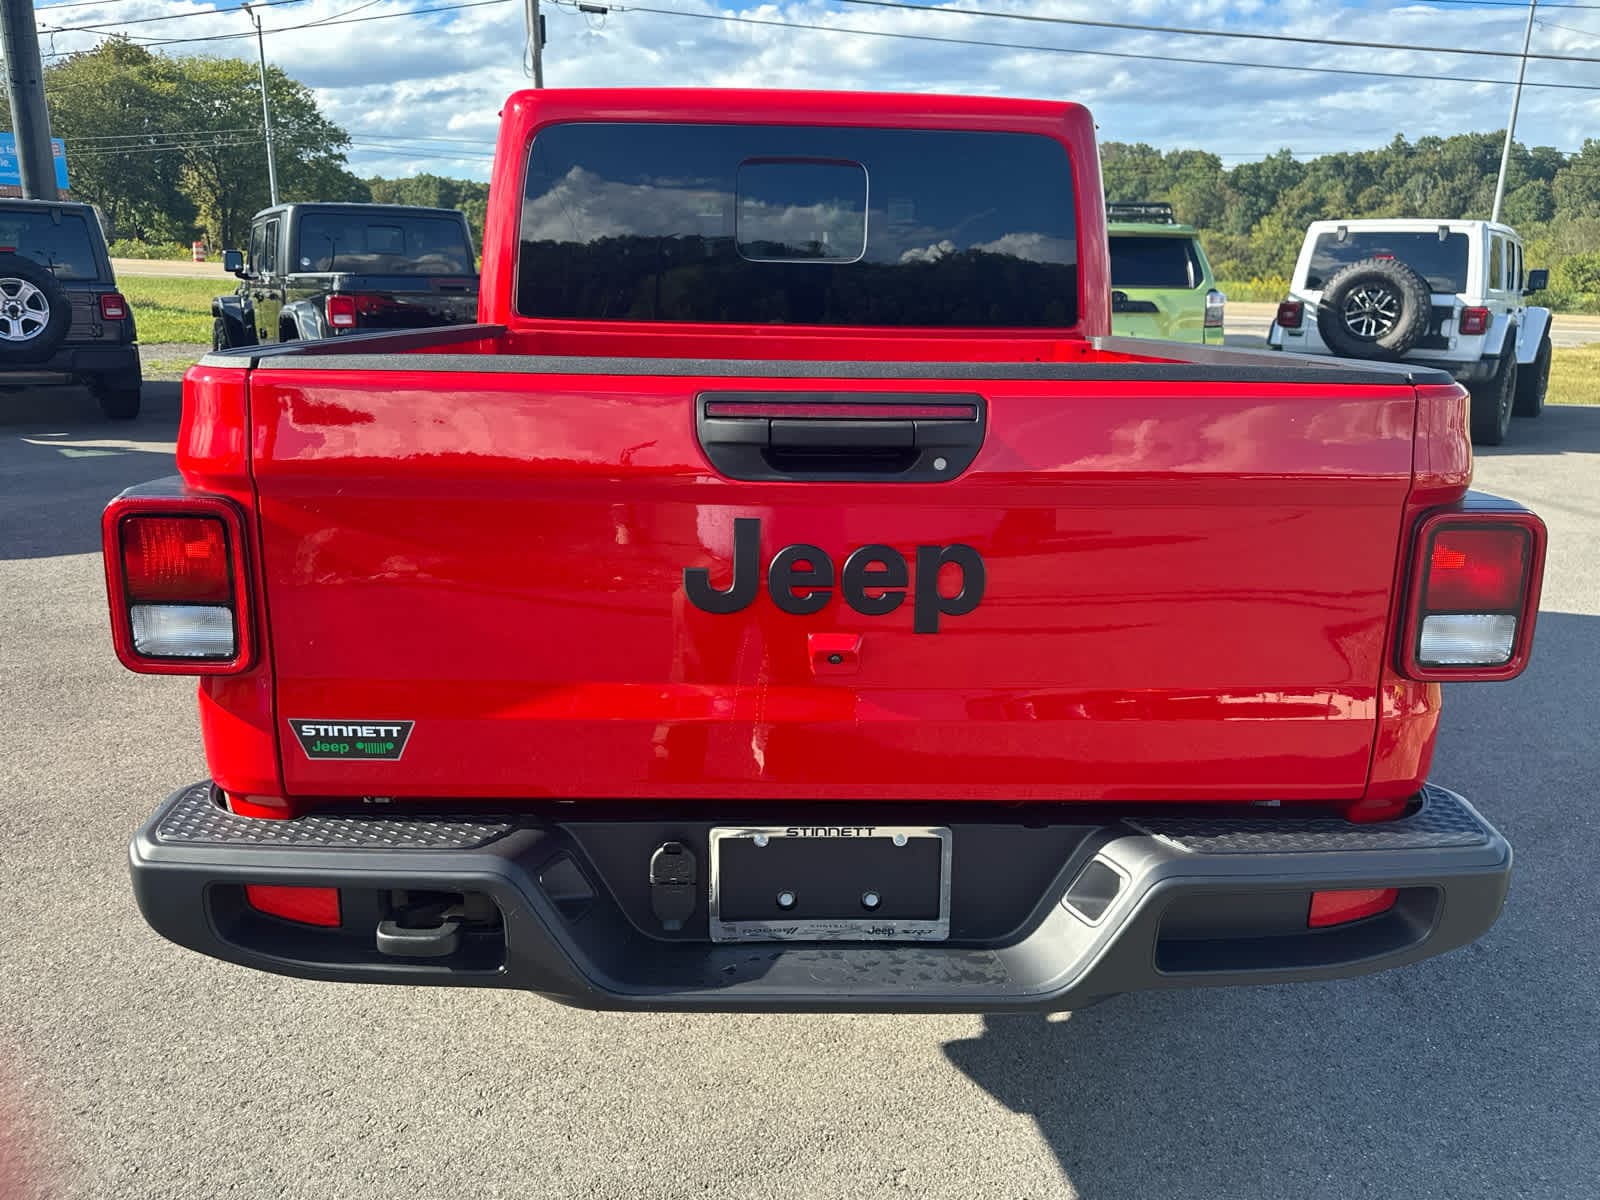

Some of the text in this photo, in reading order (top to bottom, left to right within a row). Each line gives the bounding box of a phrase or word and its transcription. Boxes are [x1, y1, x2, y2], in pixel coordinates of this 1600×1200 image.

[682, 518, 986, 634] Jeep
[301, 724, 402, 738] STINNETT
[312, 740, 349, 754] Jeep
[785, 827, 876, 838] STINNETT
[866, 925, 895, 937] Jeep
